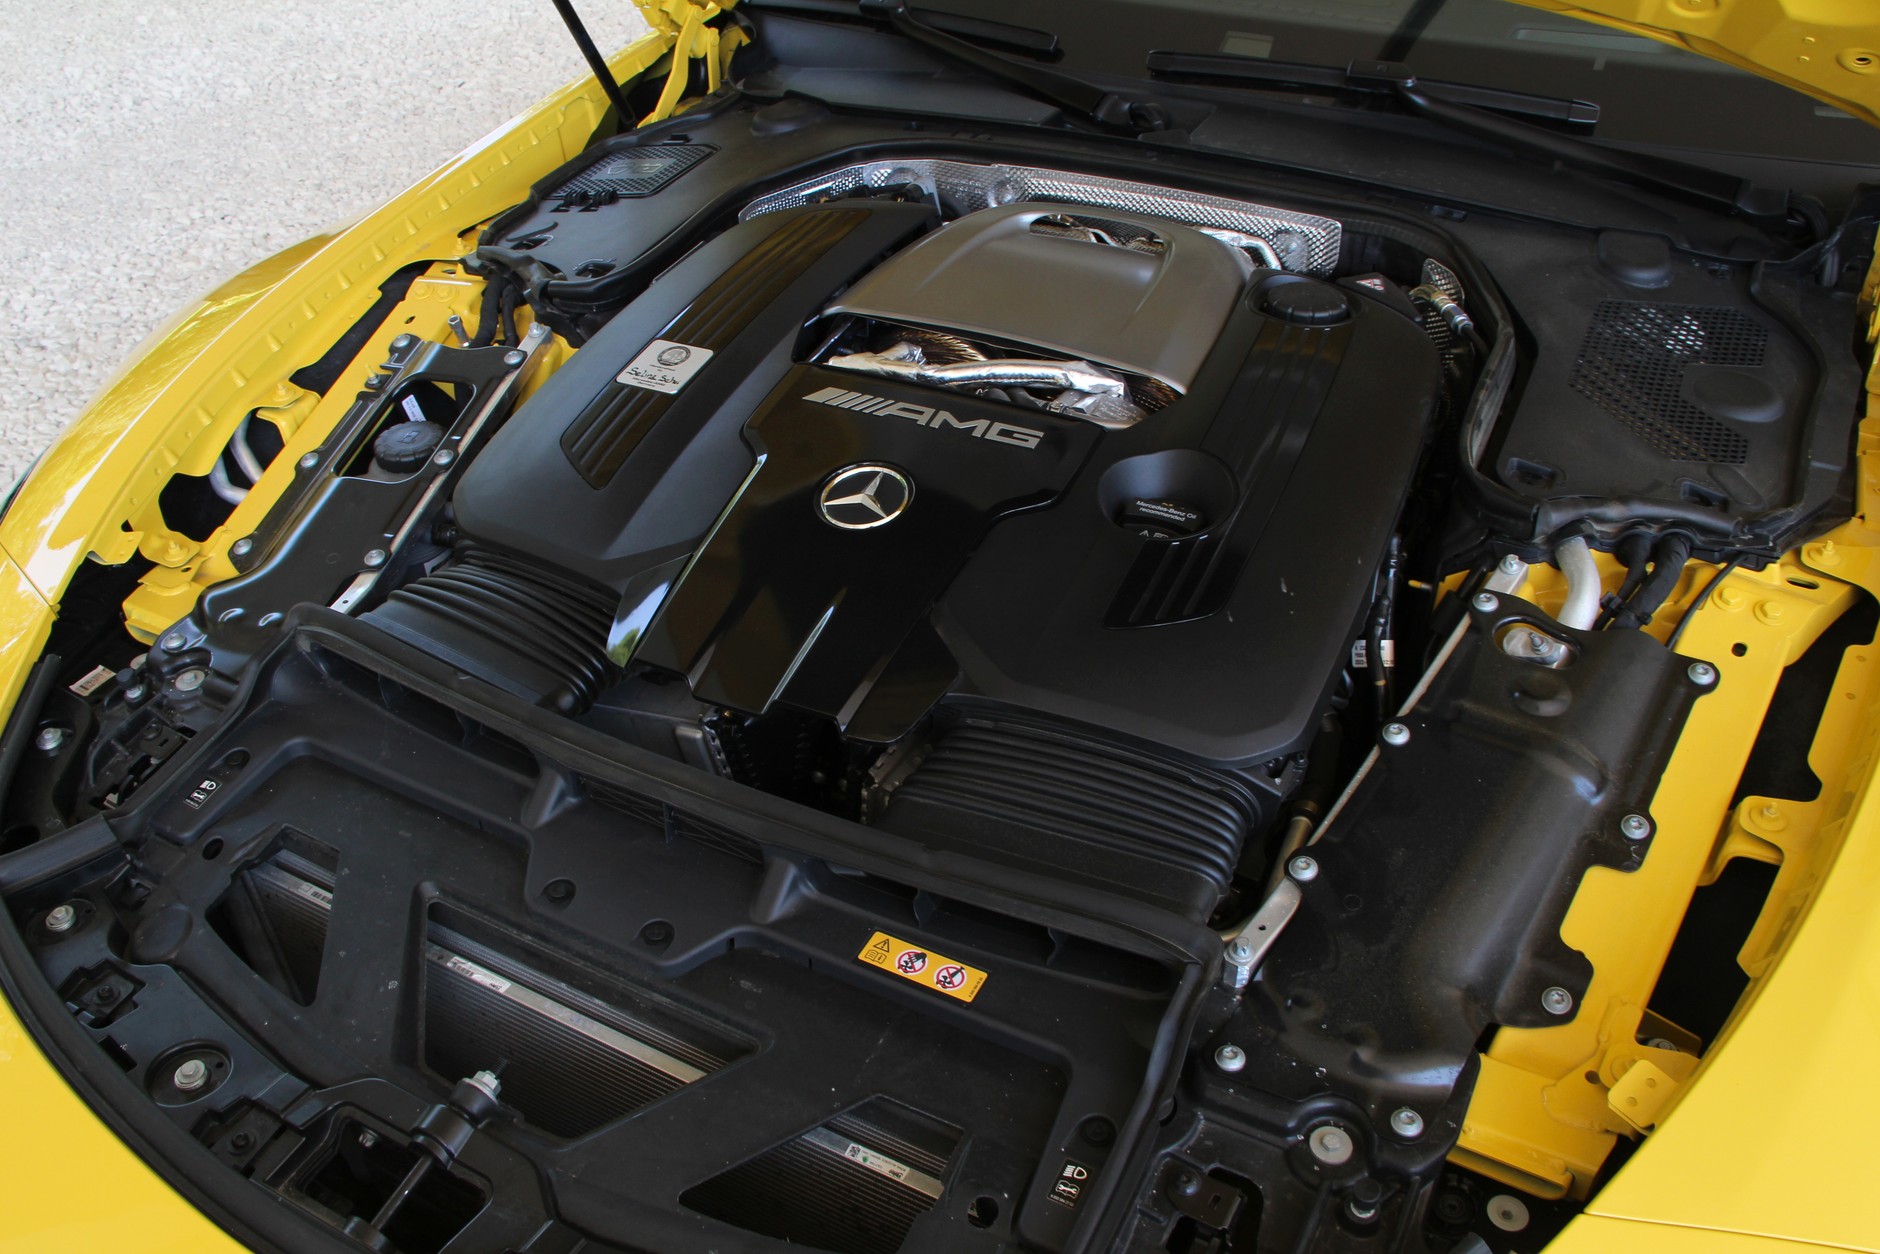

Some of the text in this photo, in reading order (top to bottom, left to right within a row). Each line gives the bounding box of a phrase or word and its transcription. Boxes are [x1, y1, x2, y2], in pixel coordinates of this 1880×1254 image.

[873, 401, 1045, 450] AMG
[1136, 500, 1198, 520] Mercedes-Benz Oil
[1139, 506, 1186, 522] recommended
